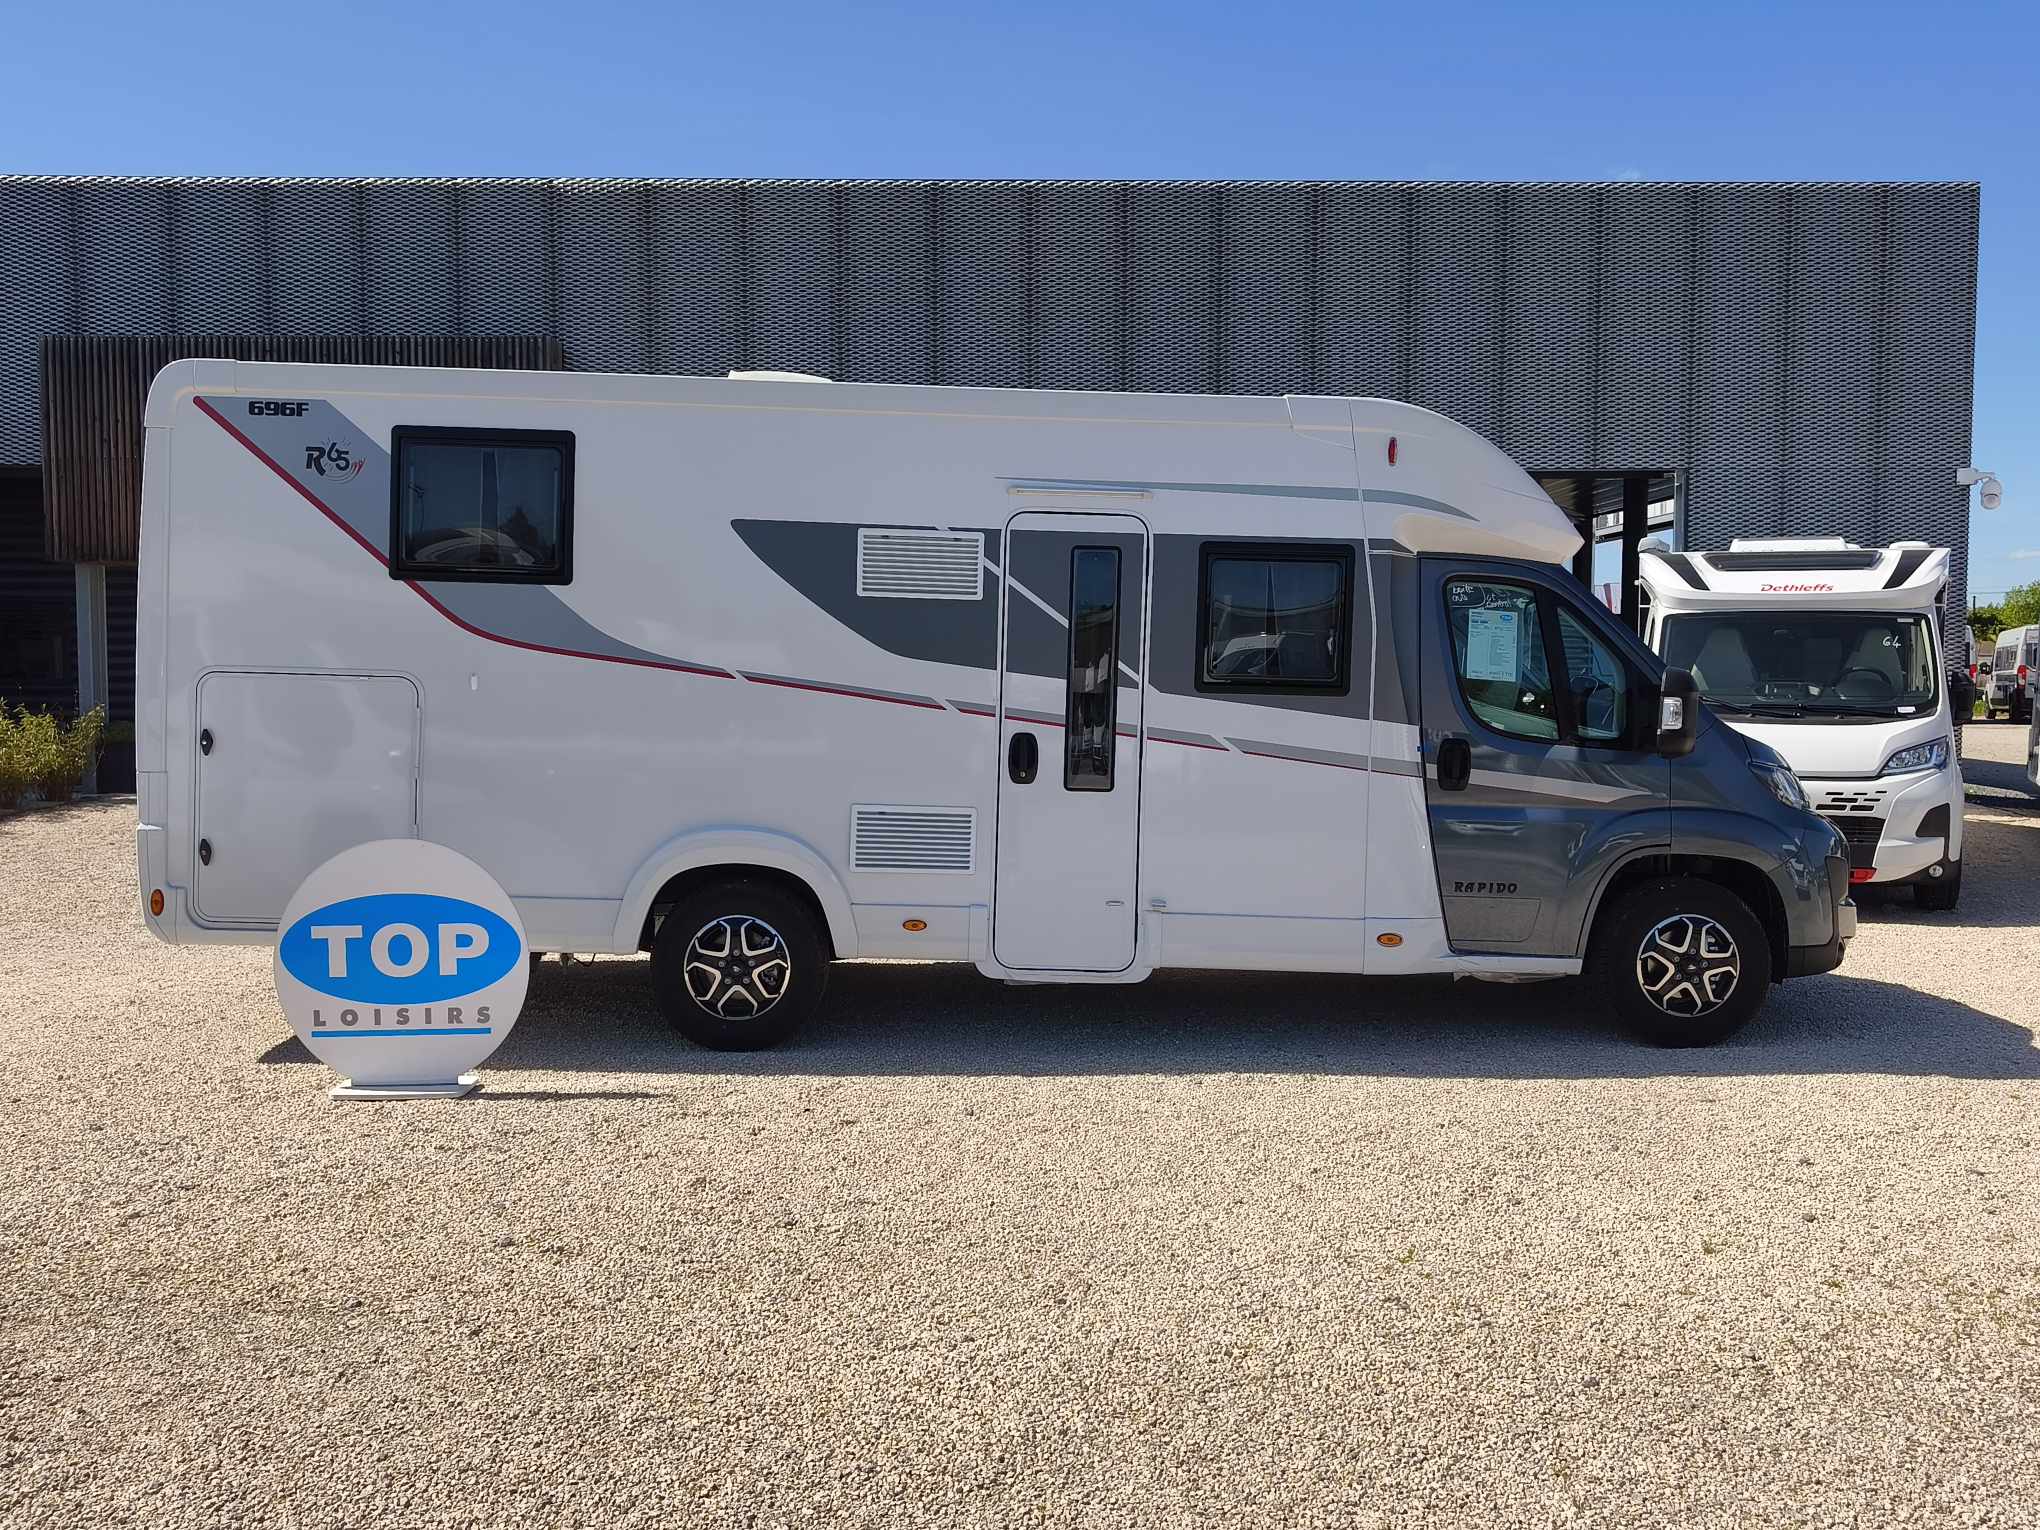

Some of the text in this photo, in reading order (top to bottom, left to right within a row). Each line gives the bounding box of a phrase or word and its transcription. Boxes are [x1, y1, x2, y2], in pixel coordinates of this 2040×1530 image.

[248, 401, 310, 417] 696F
[1760, 583, 1834, 592] Dethleffs
[1454, 881, 1518, 894] RAPIDO
[310, 922, 490, 978] TOP
[312, 1006, 491, 1027] LOISIRS
